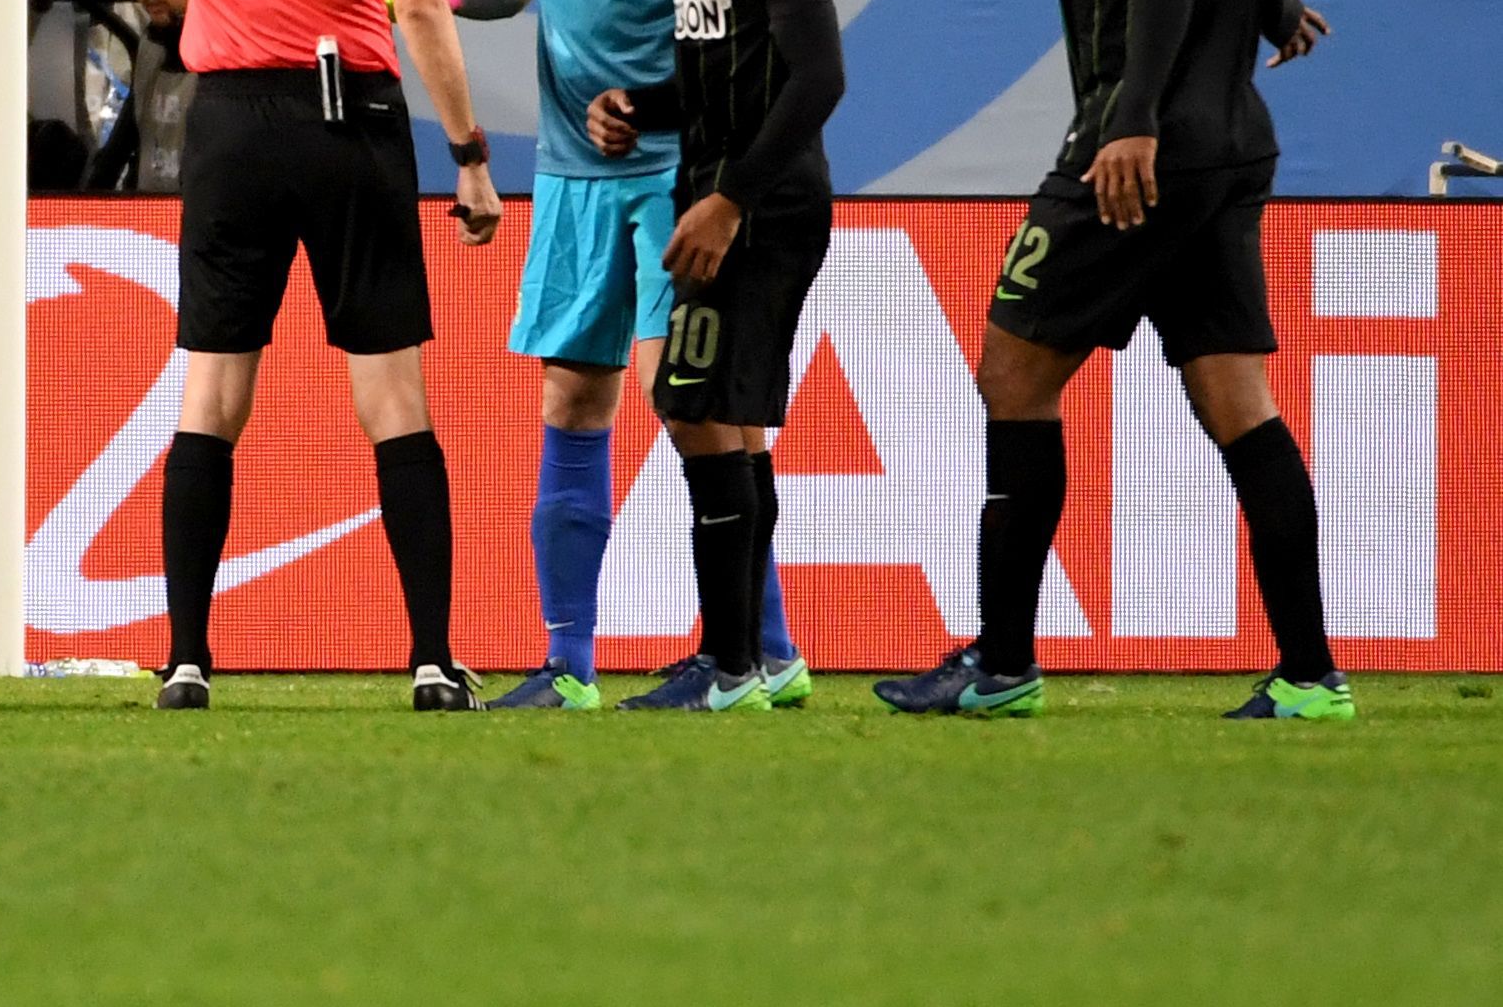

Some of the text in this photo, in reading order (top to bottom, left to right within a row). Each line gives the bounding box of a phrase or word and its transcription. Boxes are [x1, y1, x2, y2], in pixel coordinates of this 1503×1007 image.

[1002, 218, 1049, 289] 12
[668, 303, 720, 369] 10
[592, 227, 1439, 639] Ali
